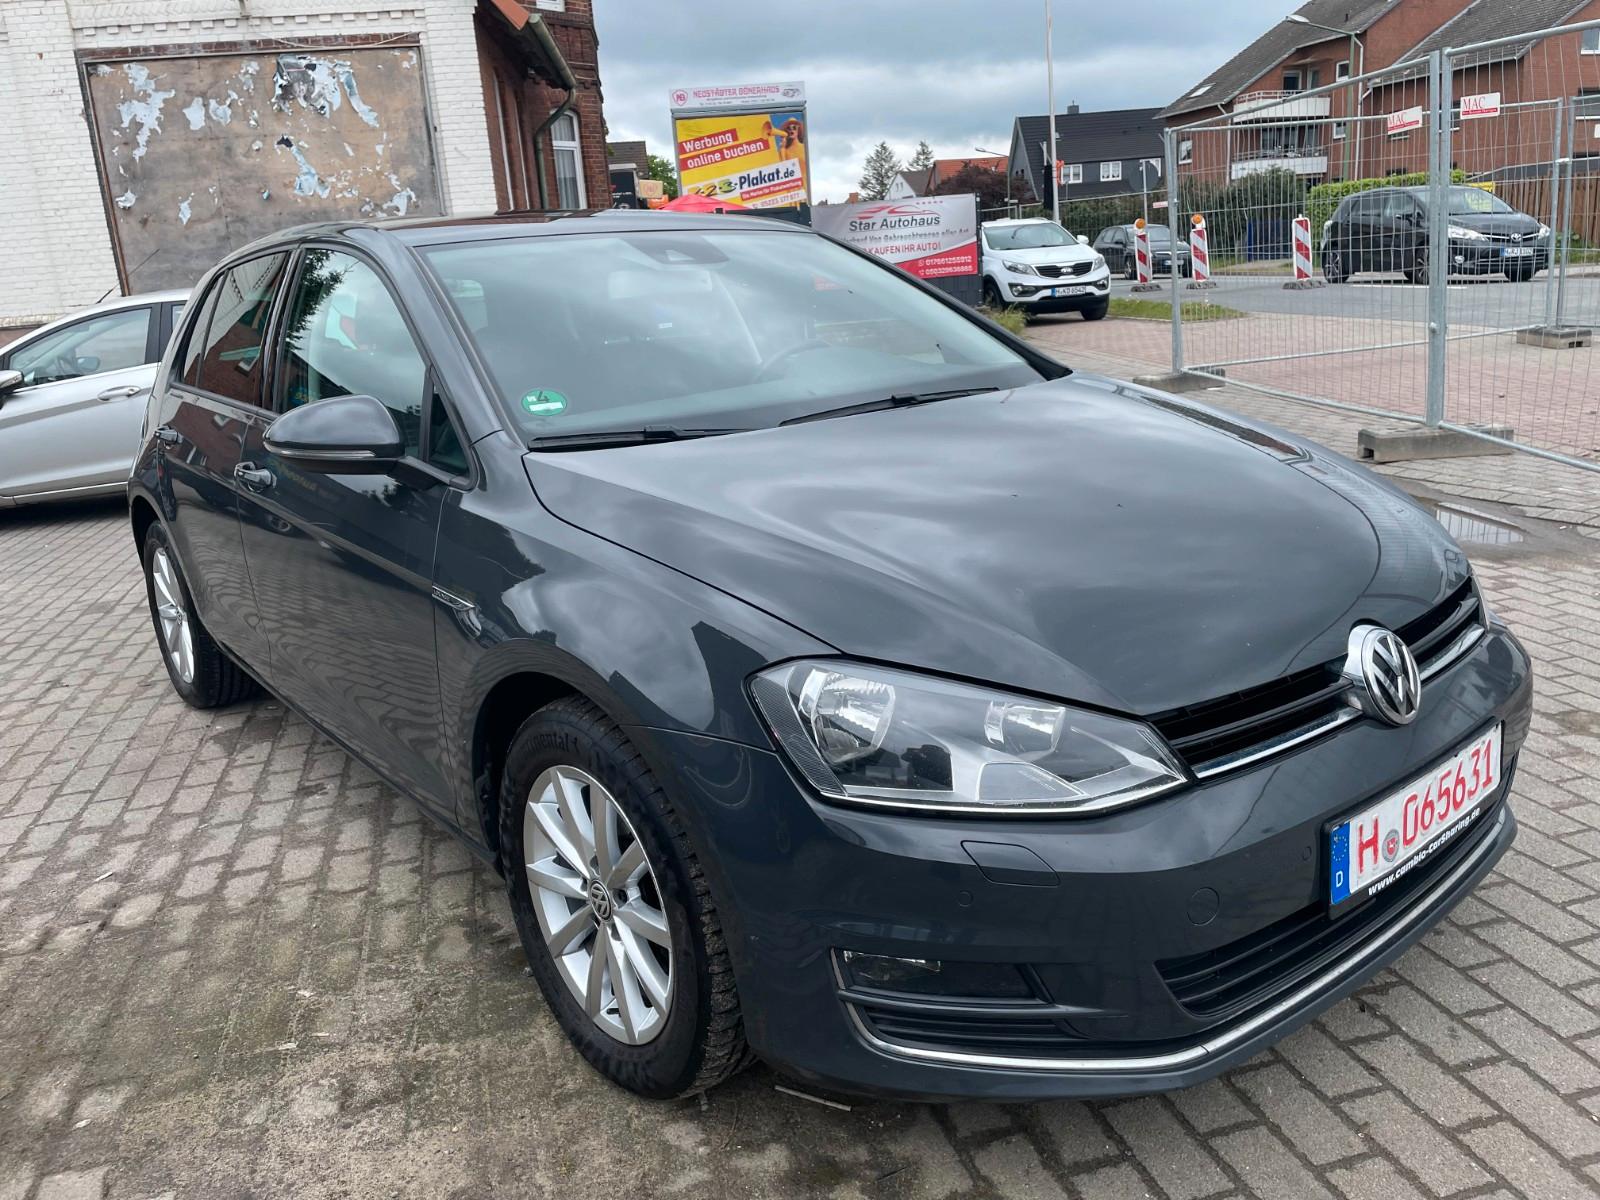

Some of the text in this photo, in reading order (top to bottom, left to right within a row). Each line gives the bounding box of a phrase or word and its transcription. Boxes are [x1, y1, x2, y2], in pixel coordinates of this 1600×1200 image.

[1463, 96, 1486, 110] MAC
[1388, 111, 1408, 127] MAC
[682, 132, 733, 153] Werbung
[687, 141, 764, 169] online buchen
[849, 215, 941, 232] Star Autohaus
[867, 244, 900, 256] KAUFEN
[901, 243, 914, 252] IHR
[1357, 738, 1494, 875] H 065631
[1335, 870, 1343, 888] D
